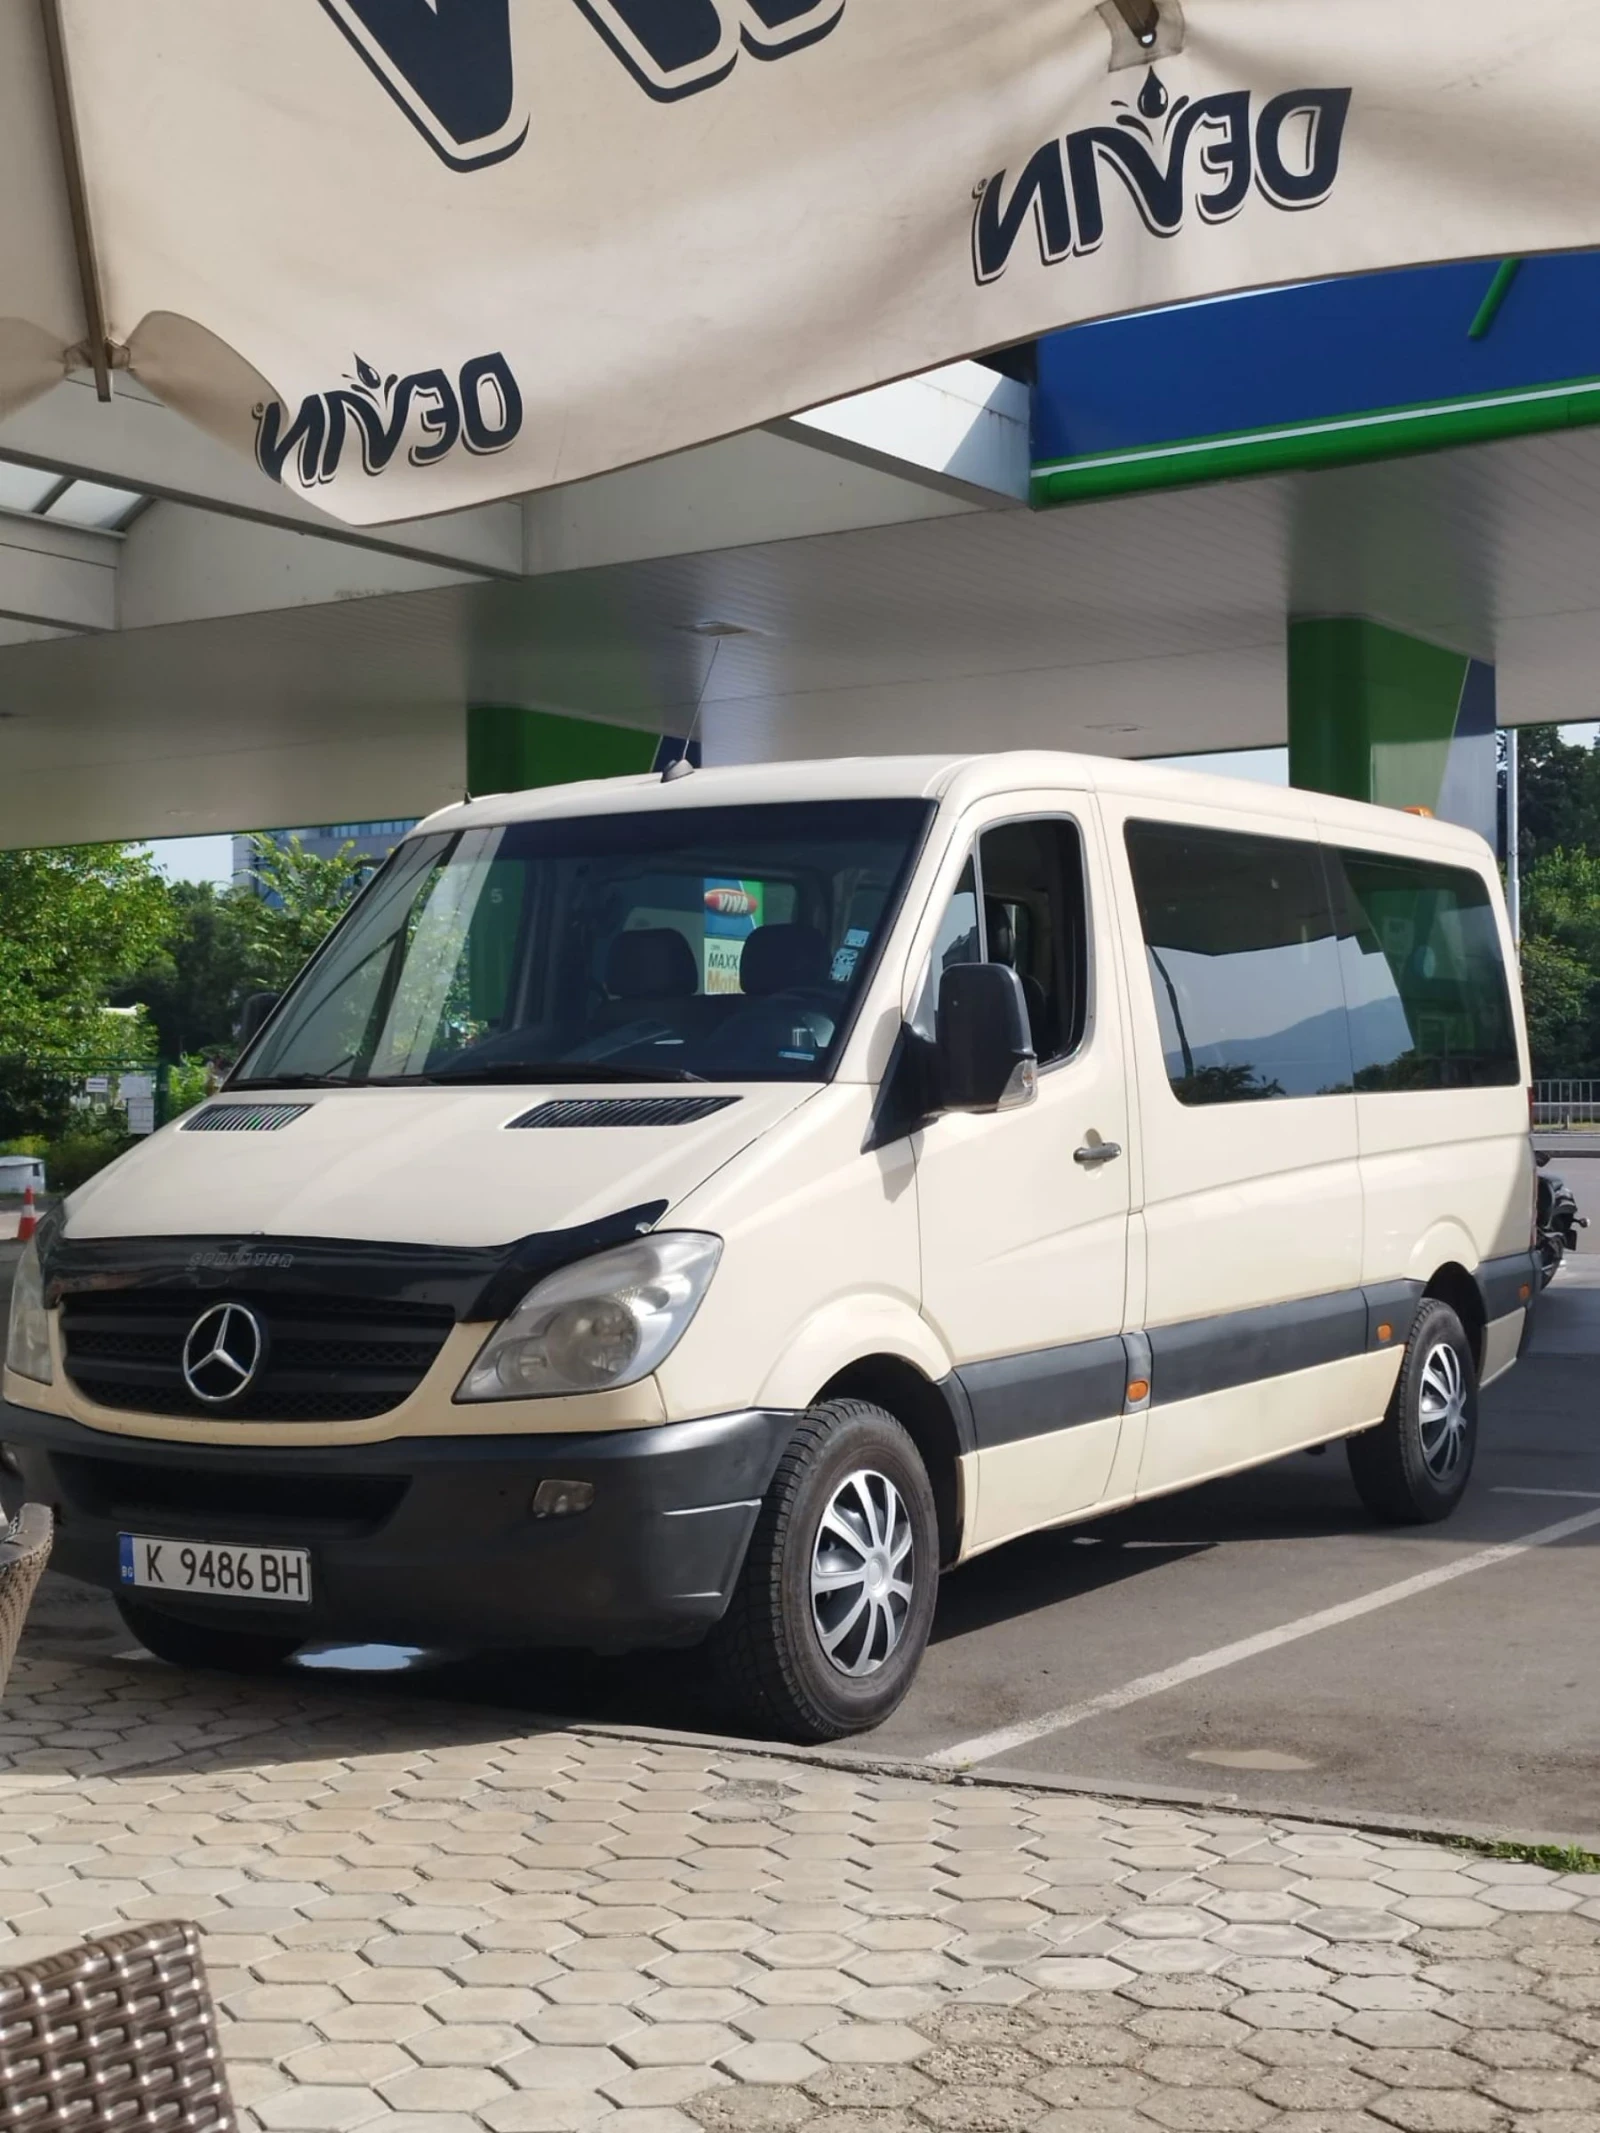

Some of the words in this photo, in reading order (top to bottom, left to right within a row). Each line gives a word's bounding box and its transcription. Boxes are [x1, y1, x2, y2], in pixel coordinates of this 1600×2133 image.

[718, 893, 749, 913] VIVA
[708, 952, 738, 971] MAXX
[121, 1565, 134, 1578] BG
[145, 1544, 164, 1583] K
[180, 1548, 254, 1591] 9486
